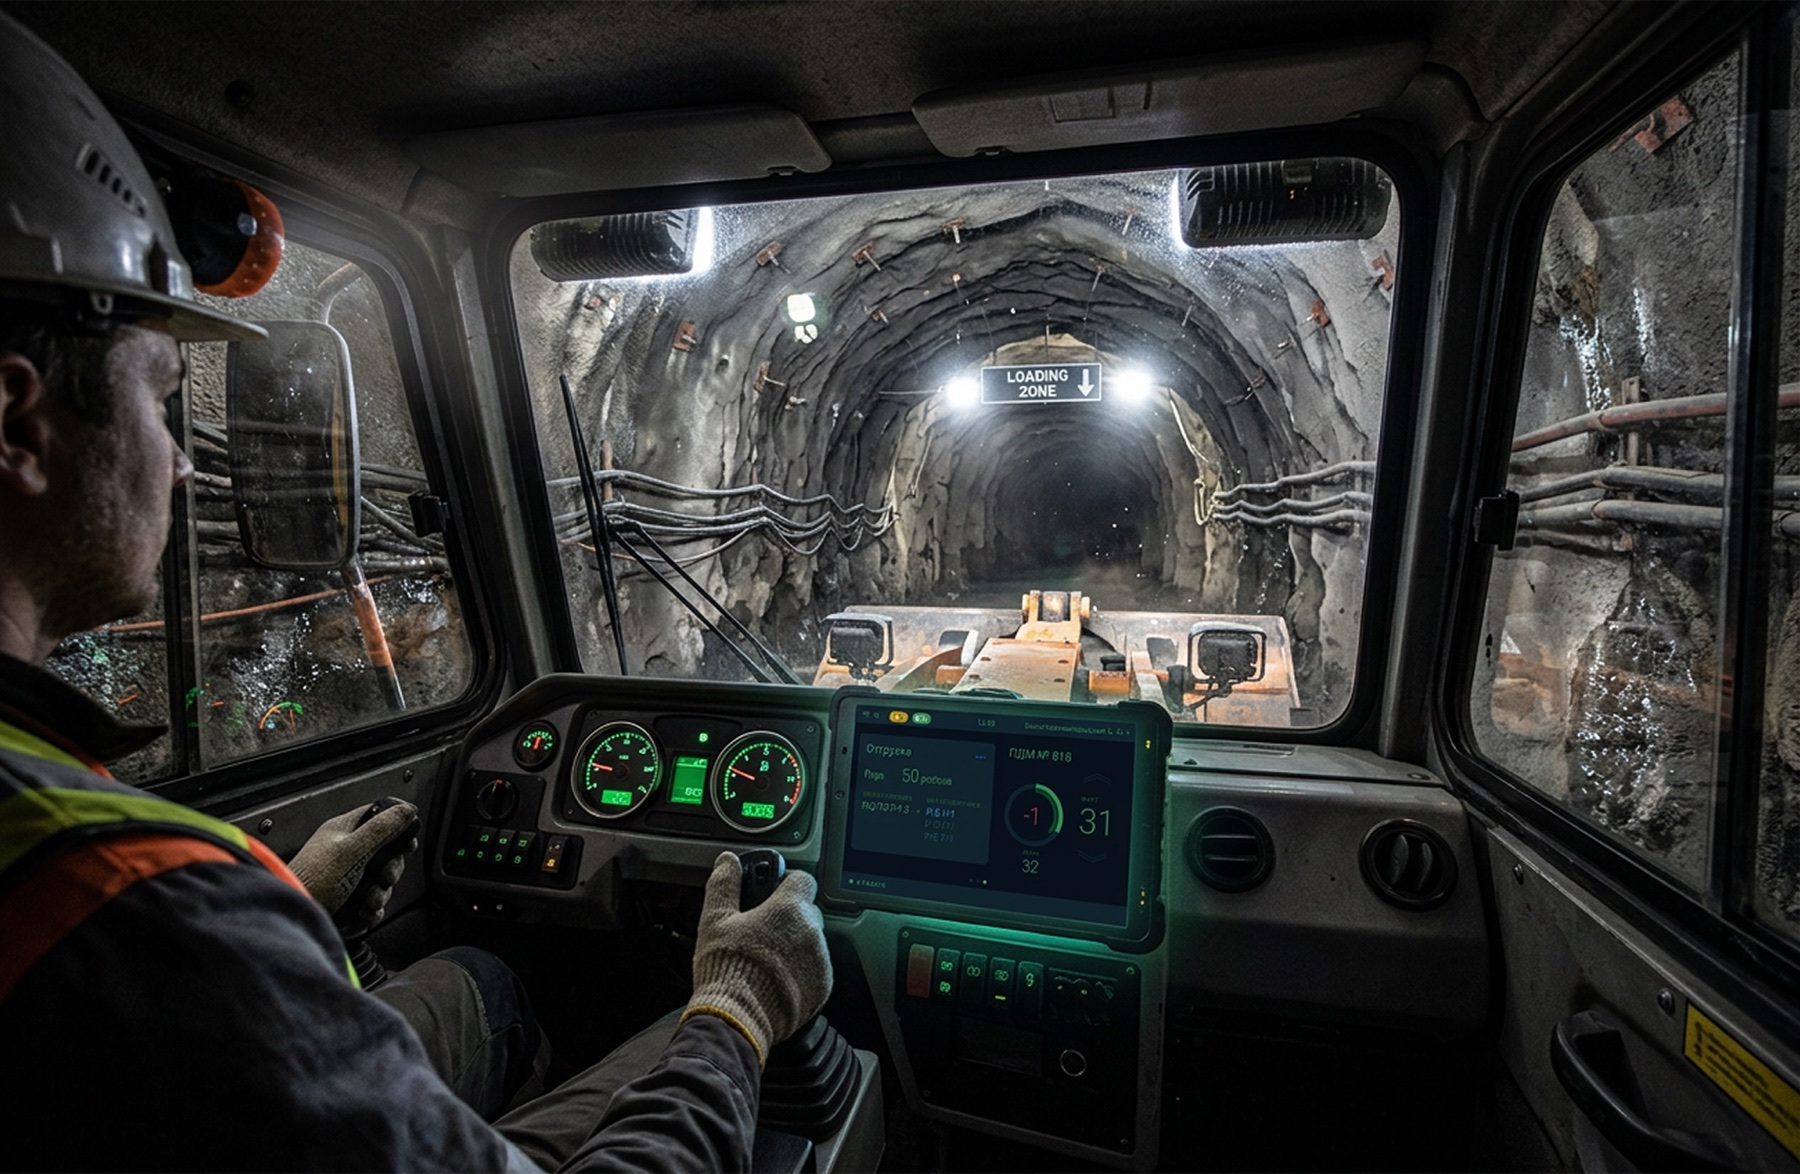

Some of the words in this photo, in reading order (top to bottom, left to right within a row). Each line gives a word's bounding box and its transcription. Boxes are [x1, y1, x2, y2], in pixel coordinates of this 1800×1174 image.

[1007, 369, 1069, 383] LOADING
[902, 768, 920, 783] 50
[1023, 806, 1039, 826] -1
[1079, 807, 1111, 837] 31
[1021, 858, 1039, 874] 32
